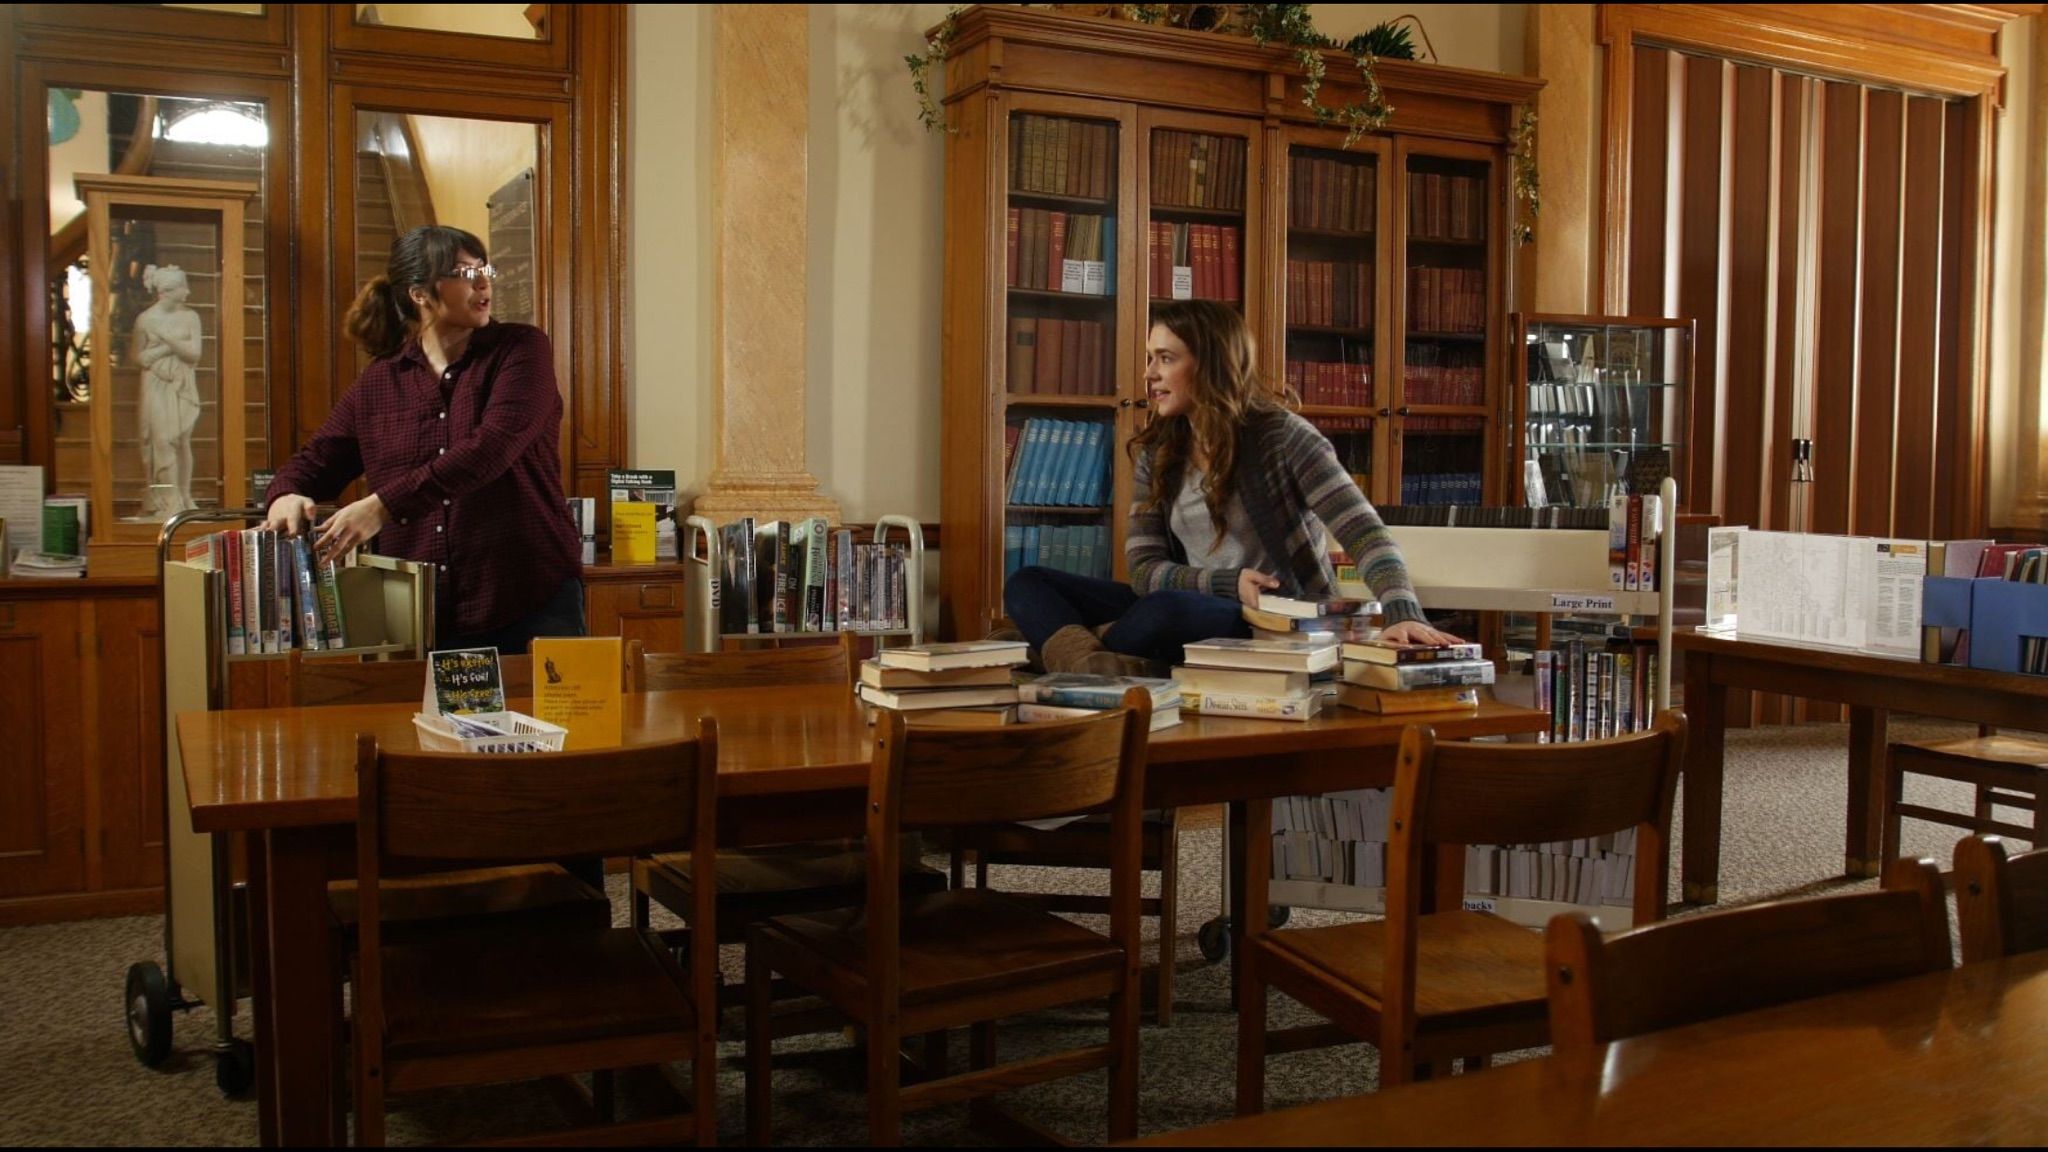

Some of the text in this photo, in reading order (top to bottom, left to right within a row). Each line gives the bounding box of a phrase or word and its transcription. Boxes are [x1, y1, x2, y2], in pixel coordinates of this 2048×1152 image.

[776, 572, 787, 613] FIRE ICE
[1552, 597, 1613, 609] Large Print
[451, 673, 468, 686] It's
